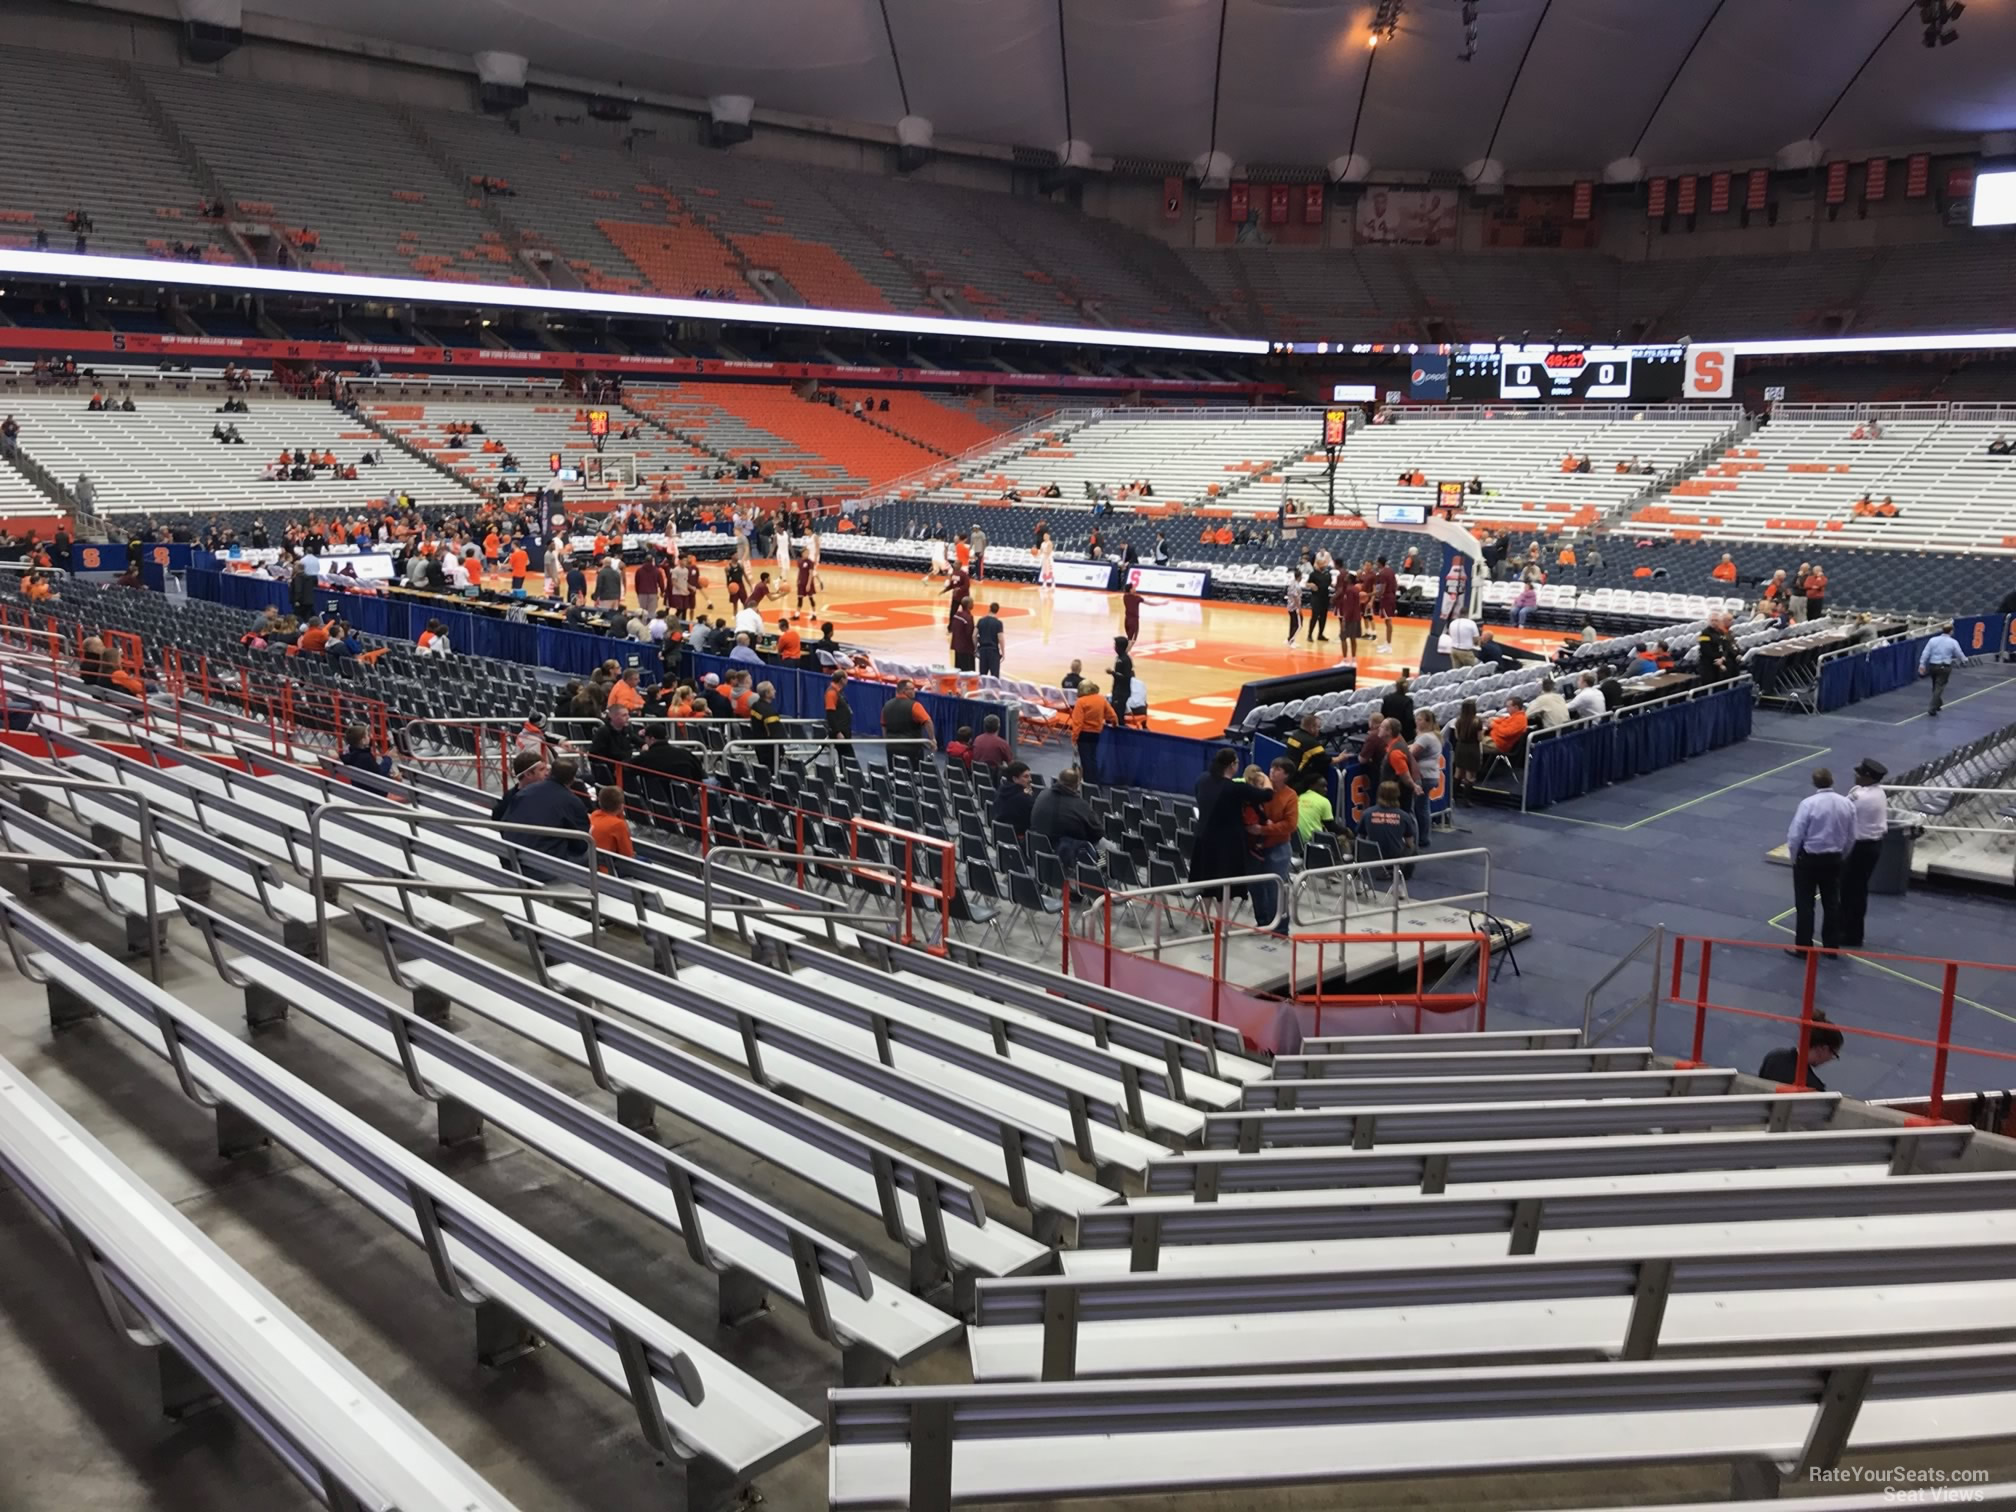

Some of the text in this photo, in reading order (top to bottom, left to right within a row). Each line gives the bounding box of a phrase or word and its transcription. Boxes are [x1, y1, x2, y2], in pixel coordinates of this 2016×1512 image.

[112, 334, 126, 350] S
[226, 338, 243, 346] TEAM
[1546, 354, 1584, 367] 49:27
[1425, 372, 1447, 382] pepsi
[1517, 366, 1531, 384] 0
[1599, 364, 1614, 384] 0
[1694, 352, 1724, 392] S
[83, 548, 100, 568] S
[154, 547, 170, 566] S
[1131, 570, 1141, 588] S
[1972, 622, 1985, 649] S
